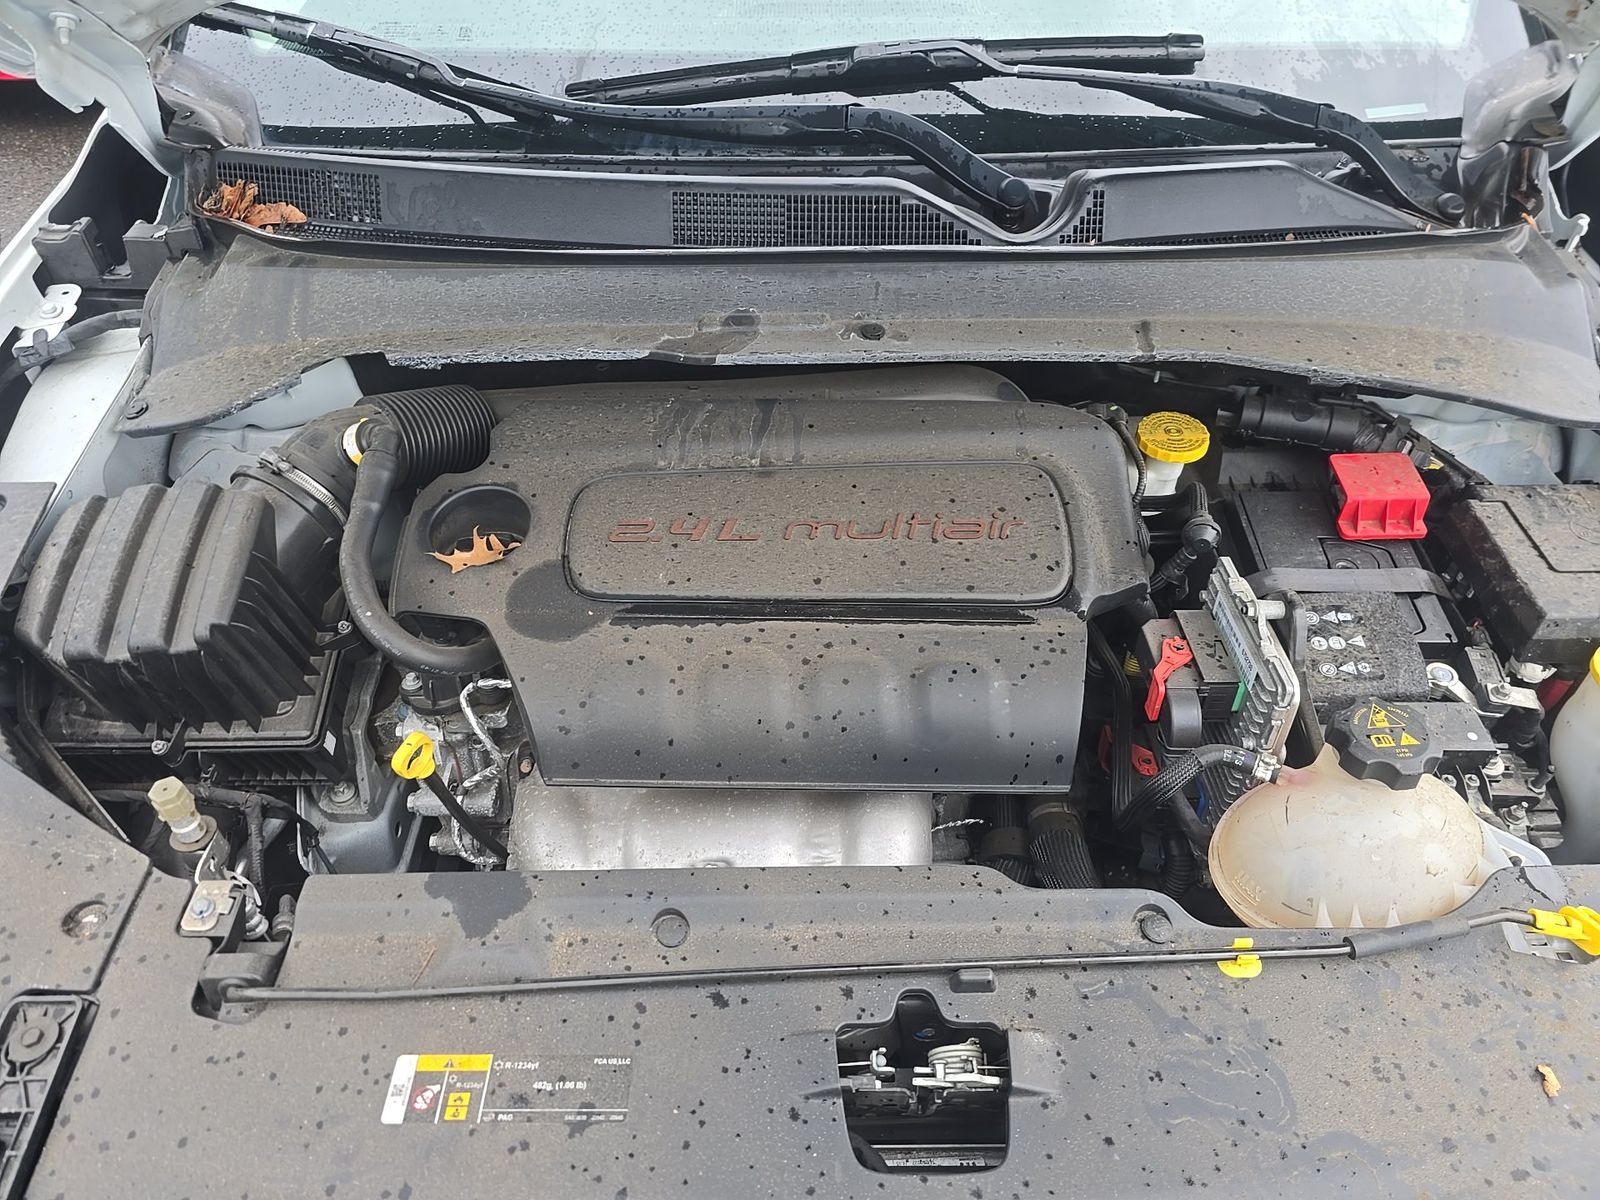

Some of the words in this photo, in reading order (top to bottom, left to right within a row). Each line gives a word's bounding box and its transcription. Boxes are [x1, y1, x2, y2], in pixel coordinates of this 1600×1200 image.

[608, 517, 760, 543] 2.4L
[784, 512, 1025, 541] multiair
[504, 1061, 540, 1070] R-1234yf
[593, 1057, 608, 1065] FCA
